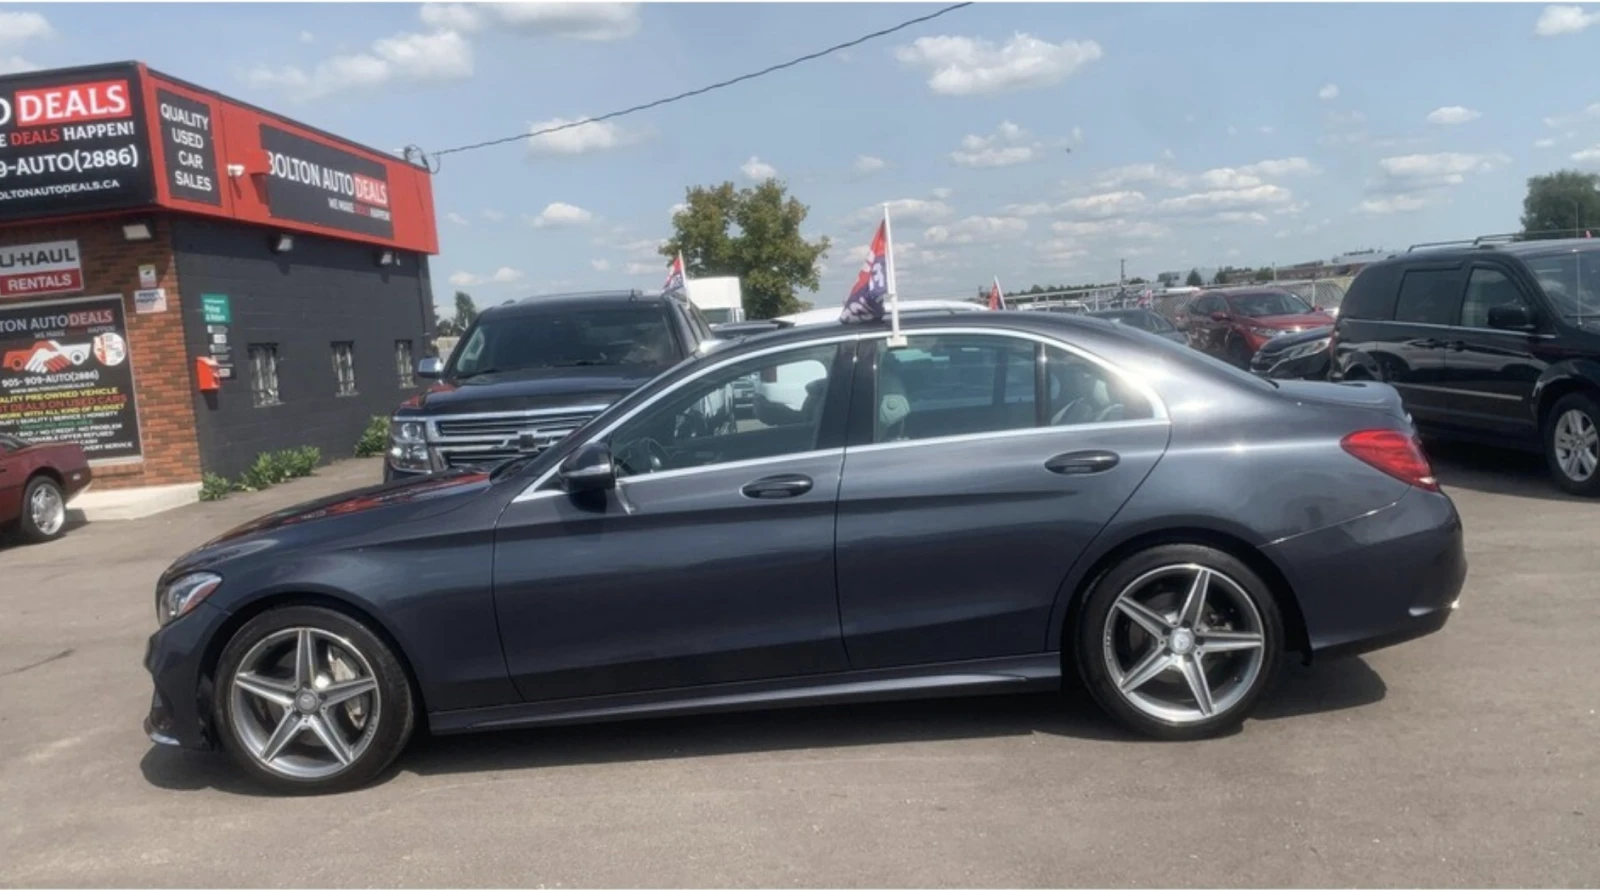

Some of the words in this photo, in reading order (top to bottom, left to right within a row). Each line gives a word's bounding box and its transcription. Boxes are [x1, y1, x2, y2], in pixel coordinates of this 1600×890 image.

[18, 85, 126, 122] DEALS
[160, 103, 209, 131] QUALITY
[11, 129, 60, 146] DEALS
[63, 121, 135, 141] HAPPEN!
[171, 128, 204, 149] USED
[177, 150, 204, 170] CAR
[268, 151, 321, 187] BOLTON
[174, 170, 212, 191] SALES
[0, 248, 75, 268] U-HAUL
[8, 274, 72, 291] RENTALS
[31, 314, 68, 330] AUTO
[69, 309, 112, 326] DEALS
